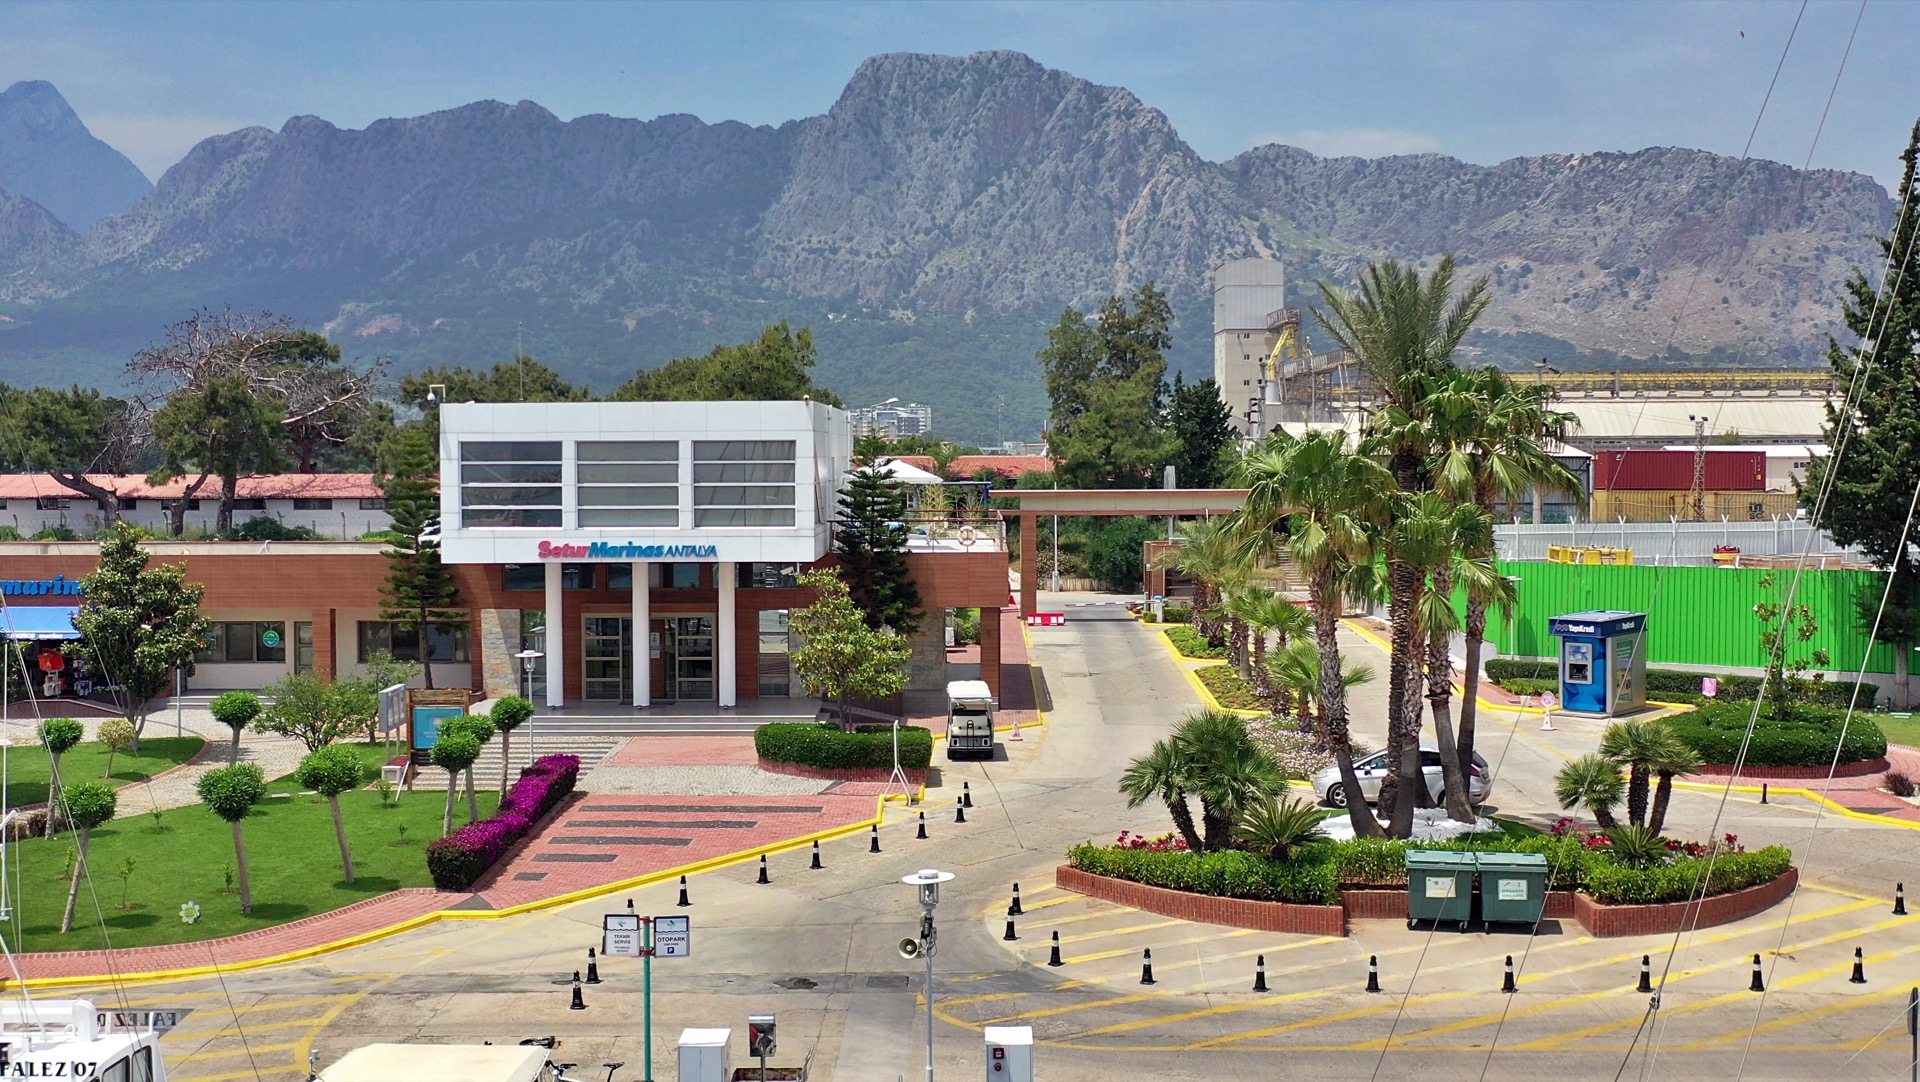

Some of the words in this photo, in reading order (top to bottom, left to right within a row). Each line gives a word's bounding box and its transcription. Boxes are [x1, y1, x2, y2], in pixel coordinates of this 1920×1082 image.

[664, 545, 718, 558] ANTALYA
[0, 574, 86, 596] marin
[0, 1061, 68, 1077] FALEZ
[74, 1062, 97, 1077] 07
